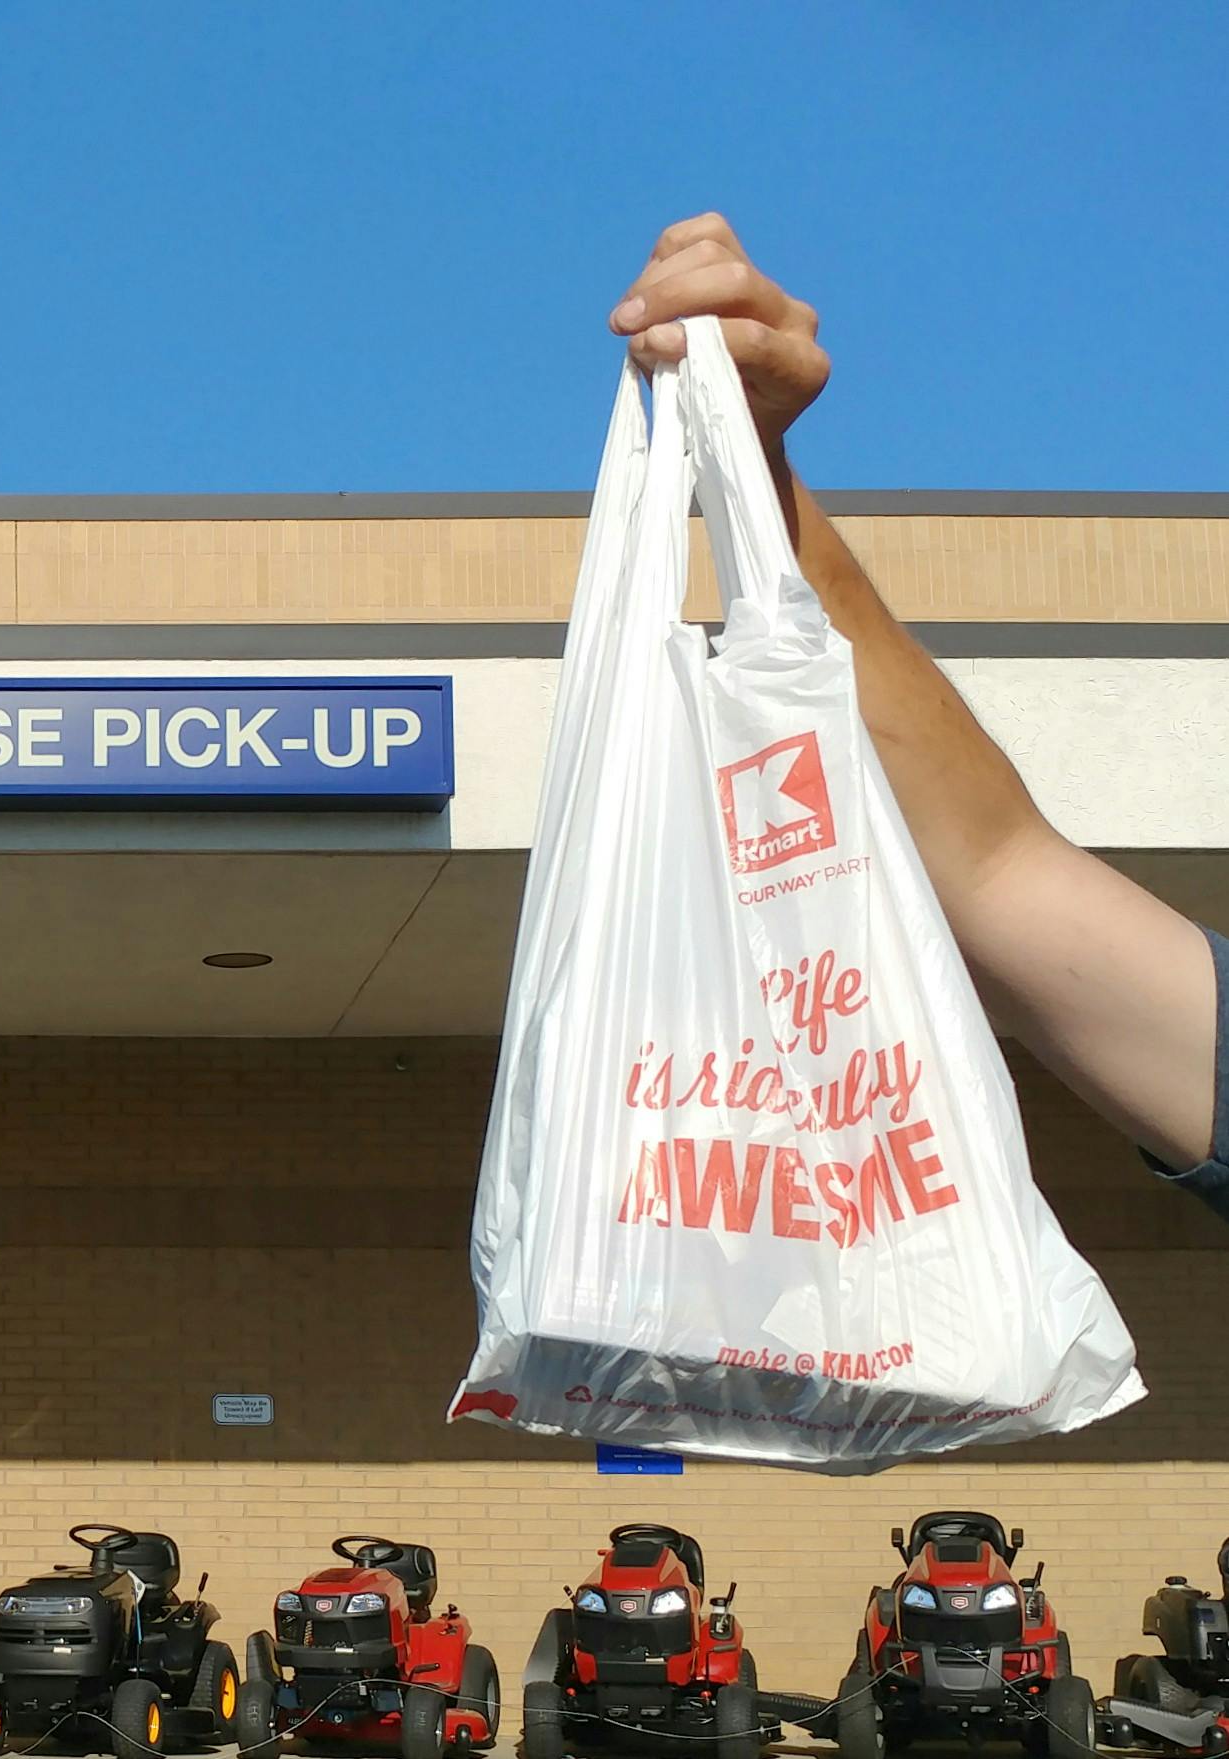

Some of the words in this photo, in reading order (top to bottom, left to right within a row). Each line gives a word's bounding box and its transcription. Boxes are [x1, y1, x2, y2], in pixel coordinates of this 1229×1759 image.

[93, 706, 423, 769] PICK-UP
[736, 818, 824, 864] Kmart
[626, 1041, 674, 1110] is
[716, 1347, 788, 1373] more
[794, 1353, 816, 1377] @
[731, 1408, 753, 1421] TO
